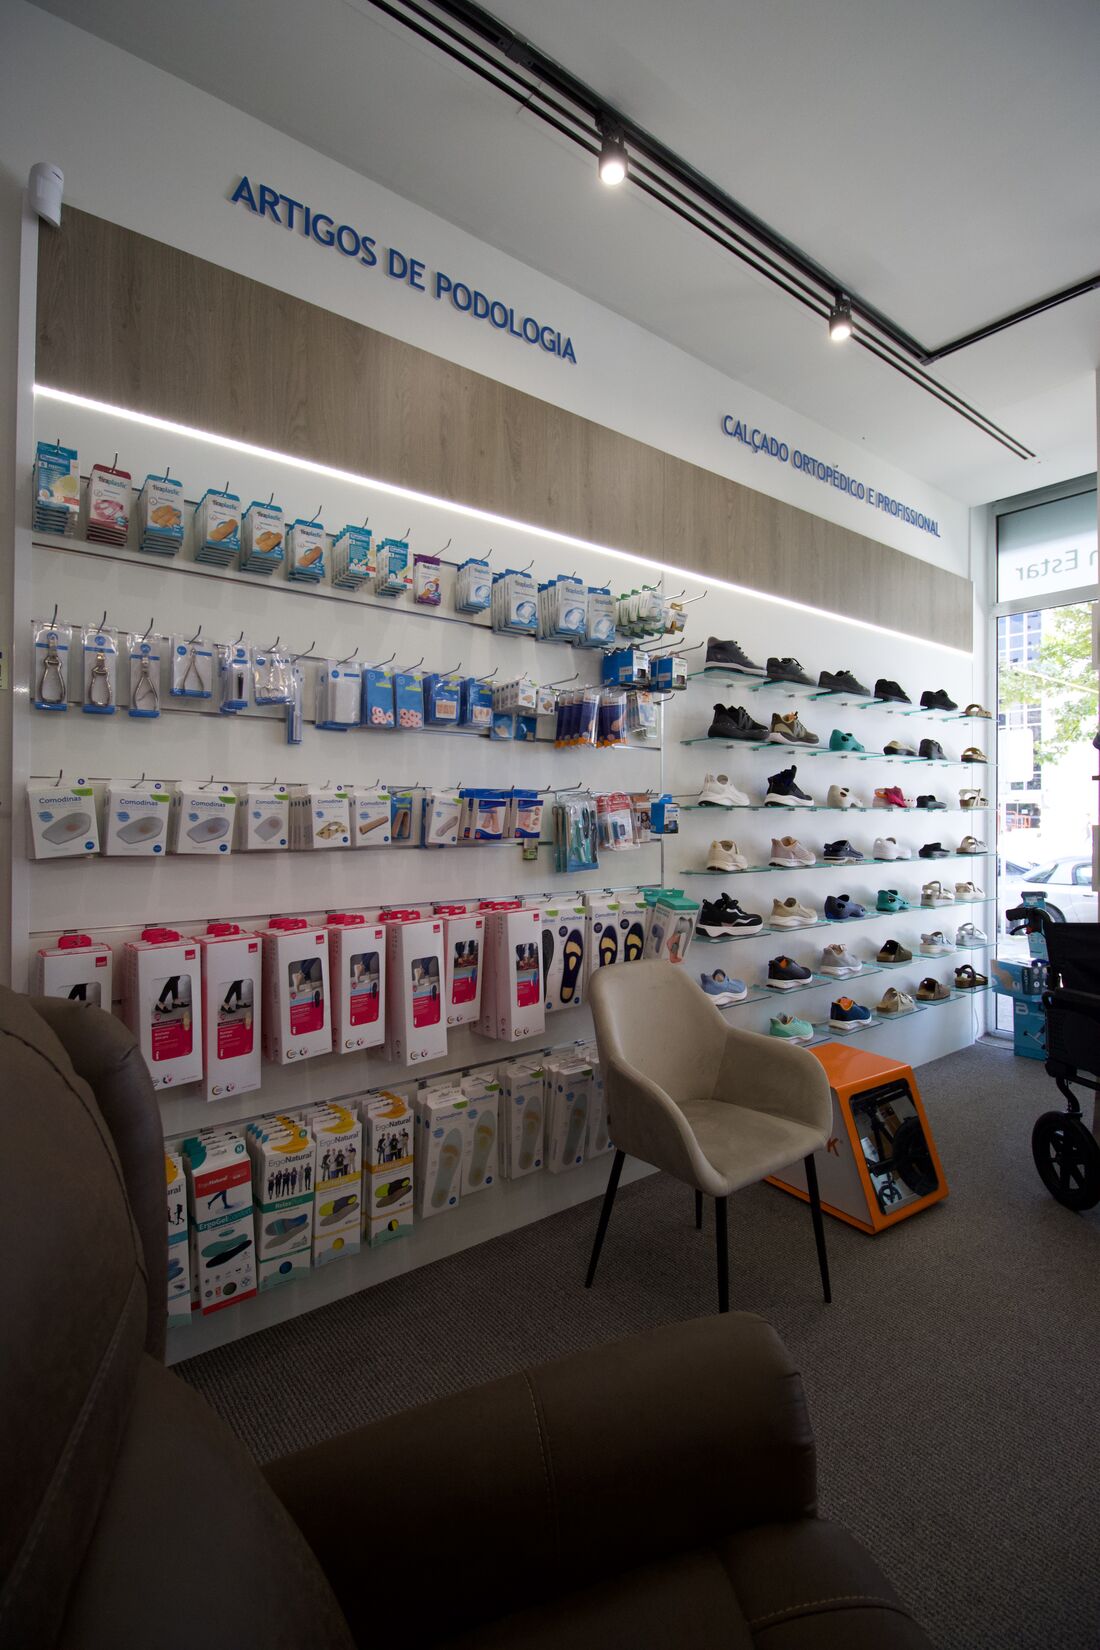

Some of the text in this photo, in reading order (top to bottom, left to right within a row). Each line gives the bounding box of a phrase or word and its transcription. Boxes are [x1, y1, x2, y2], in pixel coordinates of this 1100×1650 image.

[232, 175, 577, 364] ARTIGOS DE PODOLOGIA
[723, 414, 942, 539] CALÇADO ORTOPÉDICO E PROFISSIONAL
[39, 796, 82, 805] Comodinas
[119, 798, 158, 807] Comodinas
[190, 799, 226, 808] Comodinas
[320, 1132, 359, 1148] ErgoNatural
[268, 1151, 312, 1169] ErgoNatural
[199, 1215, 229, 1231] ErgoGel
